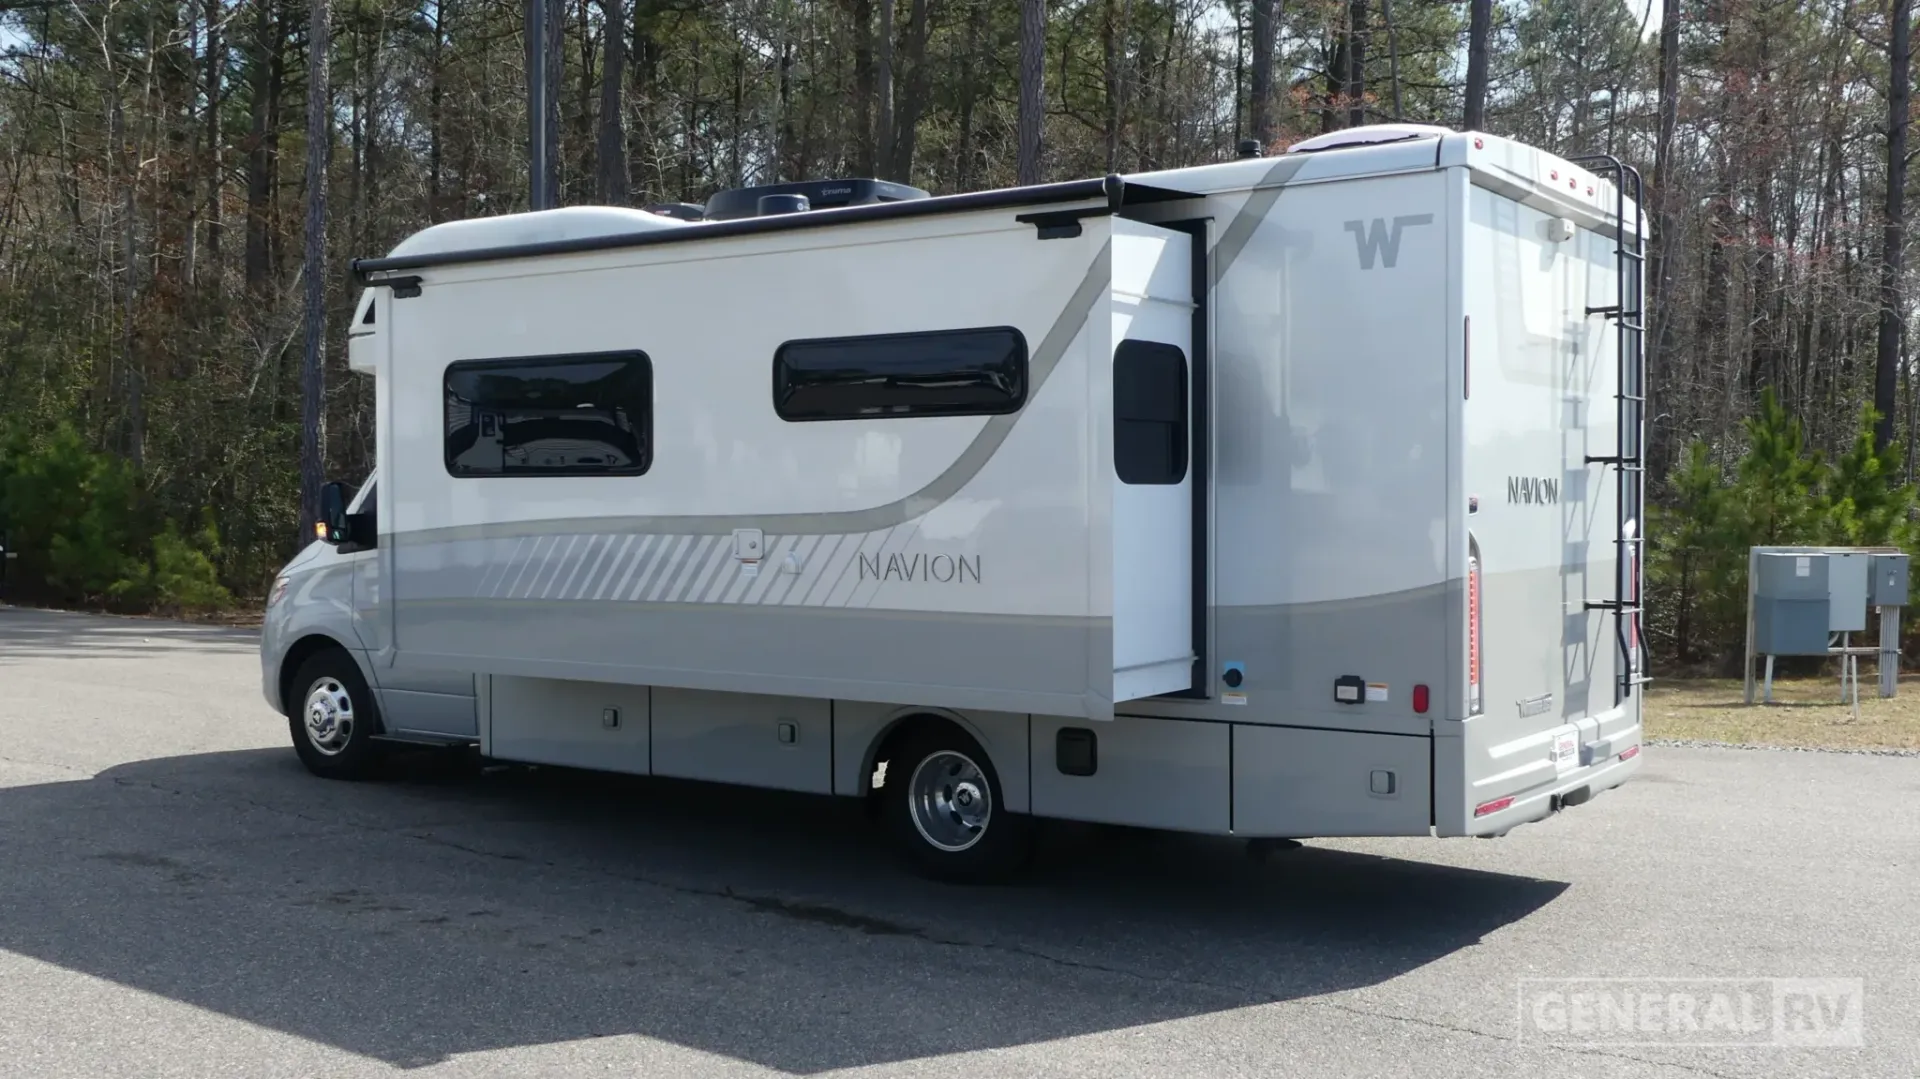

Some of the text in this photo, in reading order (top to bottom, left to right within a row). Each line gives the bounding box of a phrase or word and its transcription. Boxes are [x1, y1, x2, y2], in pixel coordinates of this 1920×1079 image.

[1344, 213, 1434, 270] W
[1508, 475, 1557, 505] NAVION
[859, 551, 981, 583] NAVION
